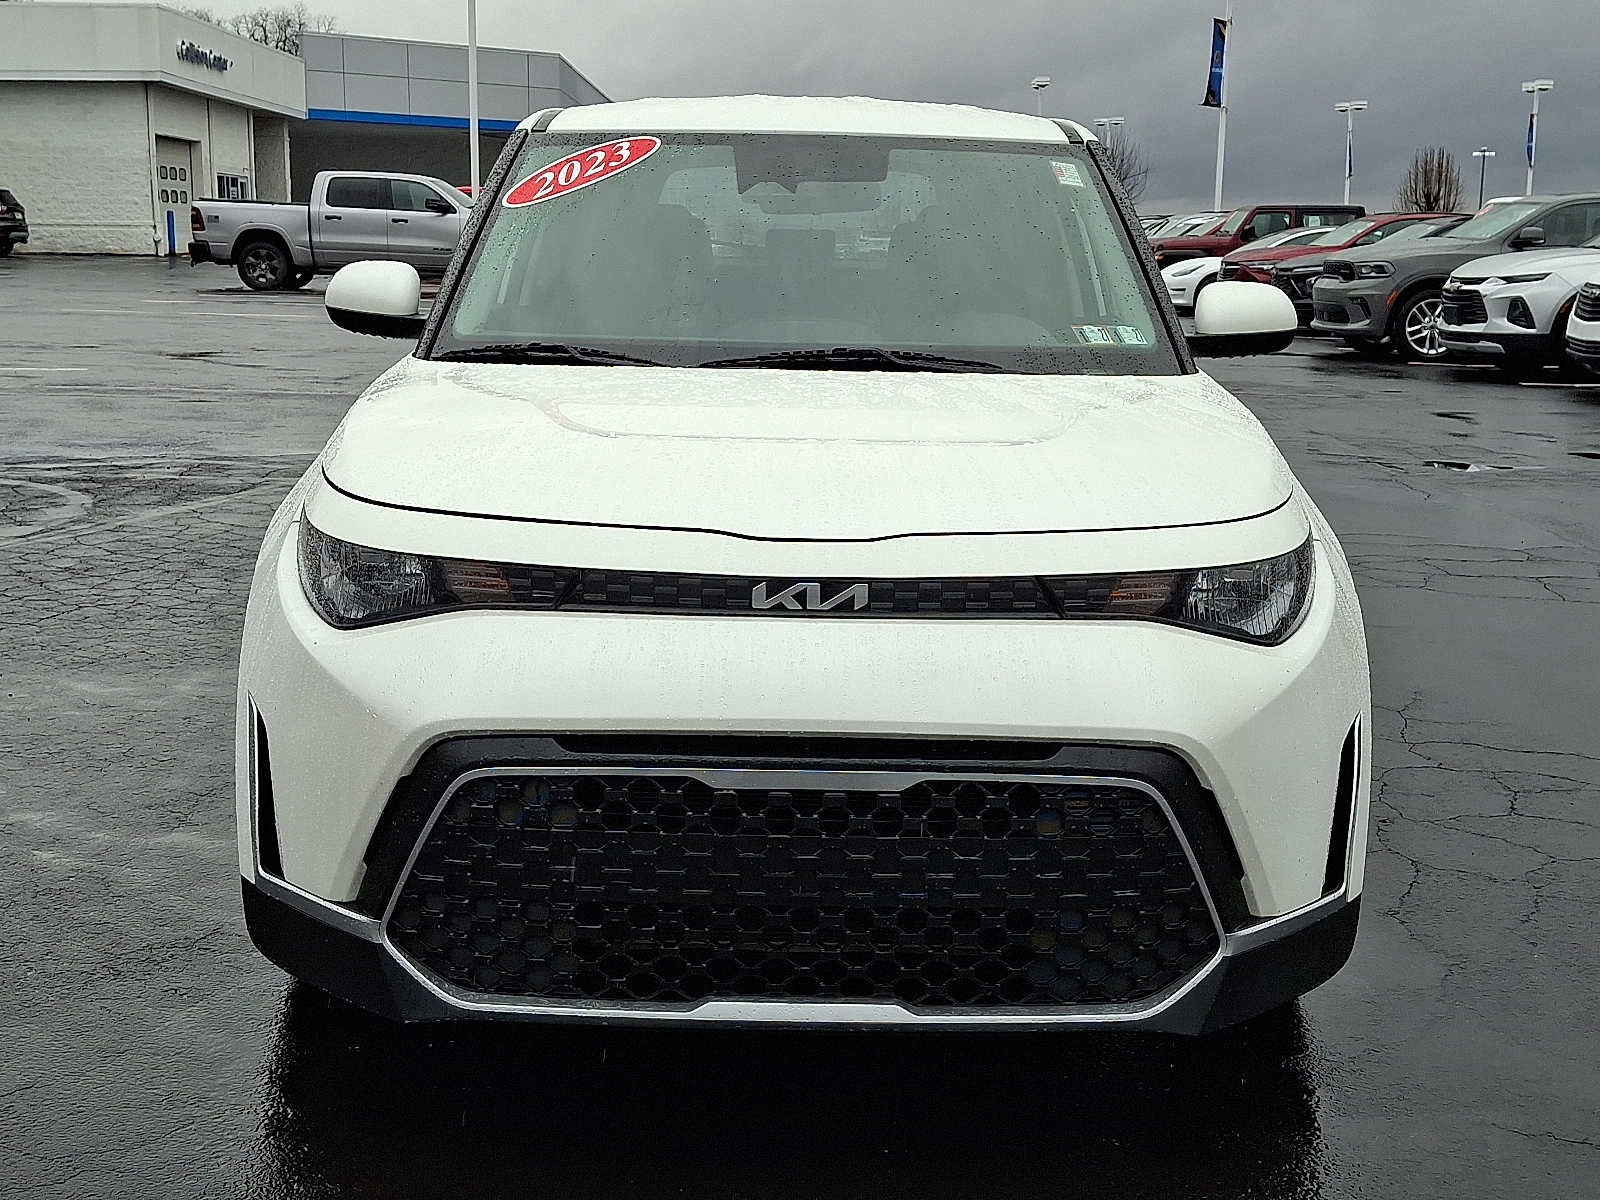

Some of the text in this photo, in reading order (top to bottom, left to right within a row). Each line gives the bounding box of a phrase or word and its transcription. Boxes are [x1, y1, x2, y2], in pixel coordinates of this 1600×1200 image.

[180, 39, 228, 72] Collision Center
[532, 141, 632, 200] 2023
[751, 581, 869, 611] KIA
